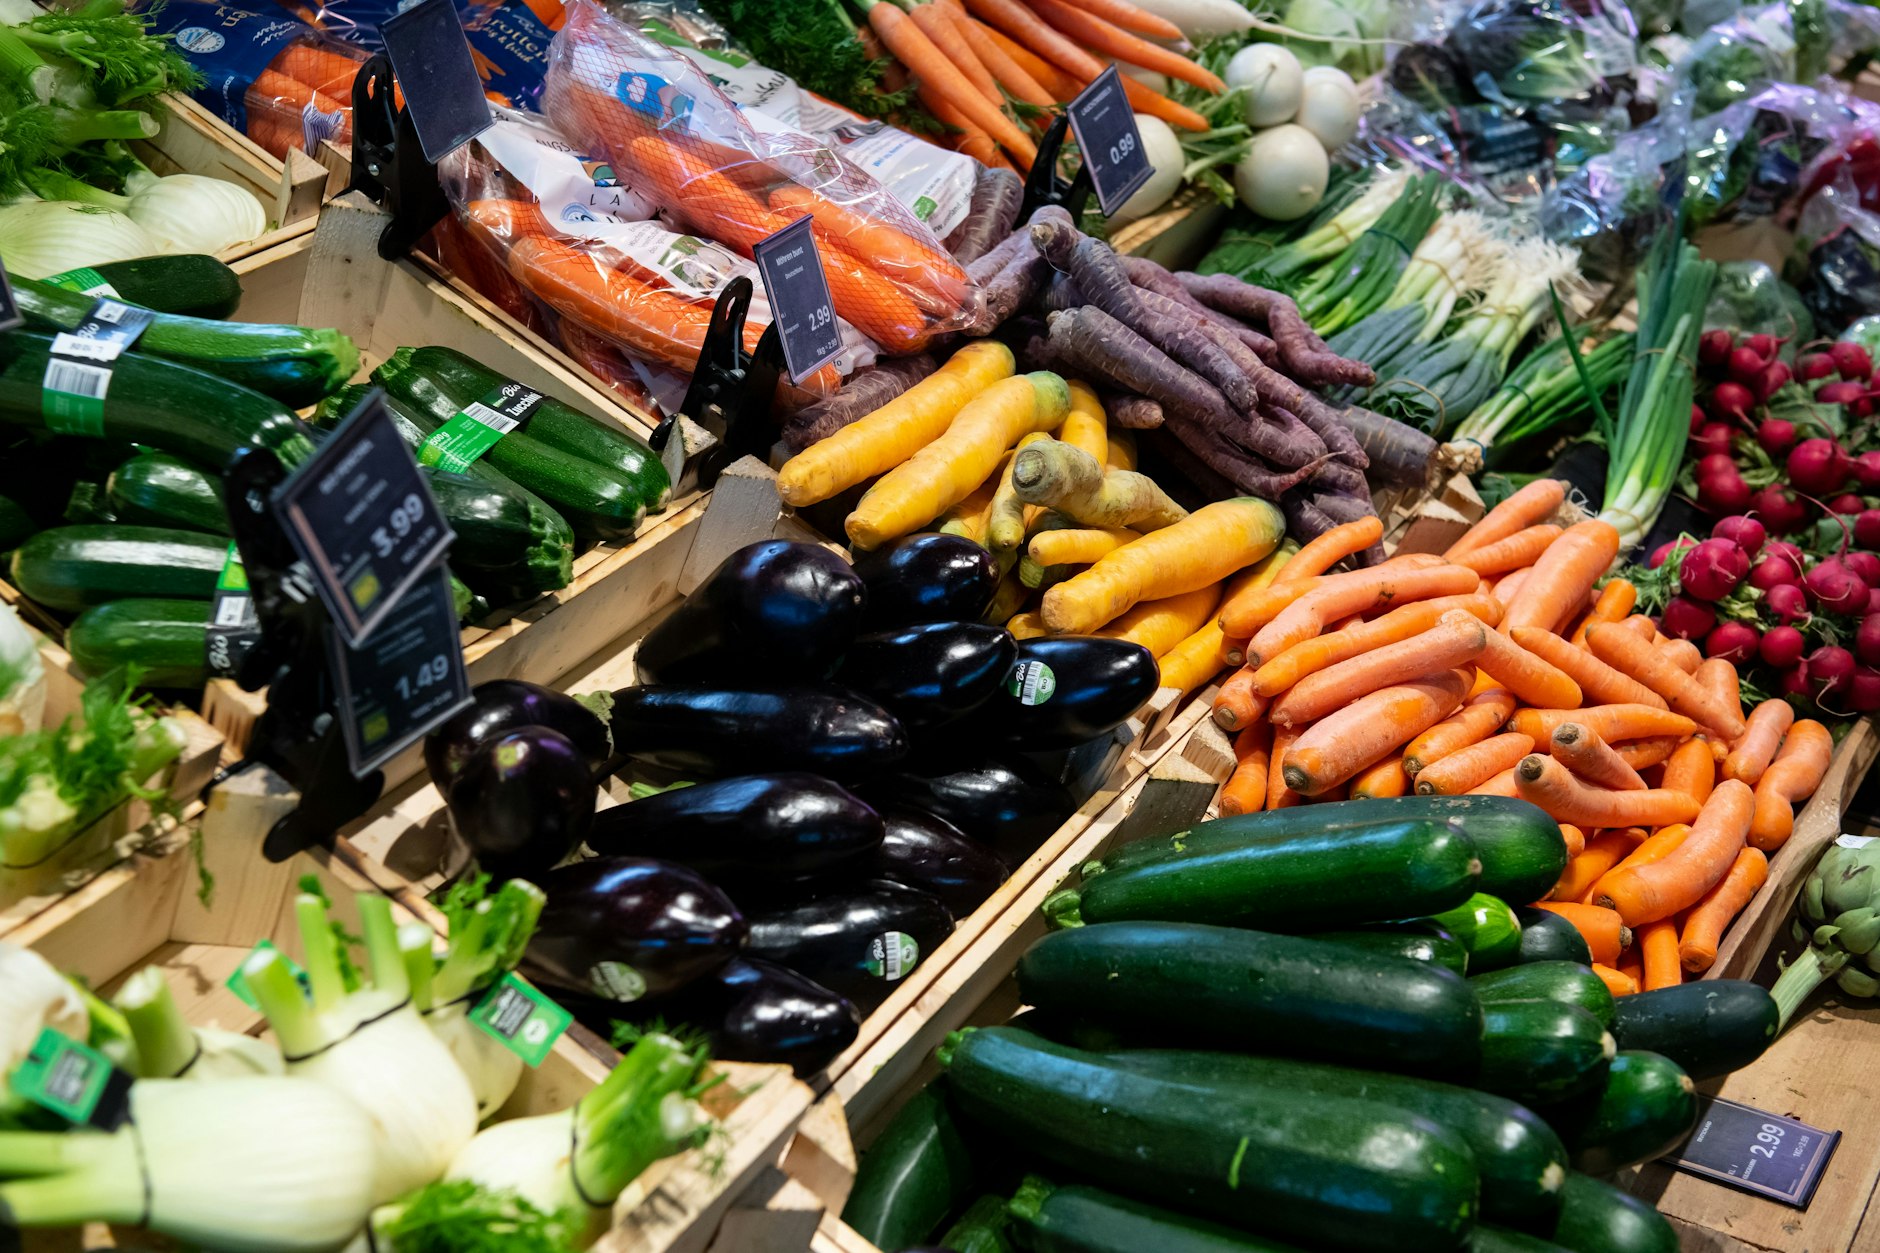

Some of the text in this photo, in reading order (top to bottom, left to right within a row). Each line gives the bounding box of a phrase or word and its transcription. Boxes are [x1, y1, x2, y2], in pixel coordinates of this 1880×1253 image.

[1109, 132, 1135, 165] 0.99
[775, 246, 804, 266] Möhren bunt
[808, 304, 831, 332] 2.99
[502, 383, 521, 398] Bio
[505, 392, 542, 417] Zucchini
[370, 493, 425, 558] 3.99
[208, 634, 232, 670] Bio
[394, 654, 449, 700] 1.49
[1015, 663, 1026, 682] Bio
[872, 938, 885, 960] Bio
[1697, 1121, 1712, 1142] DEUTSCHLAND
[1750, 1123, 1786, 1159] 2.99
